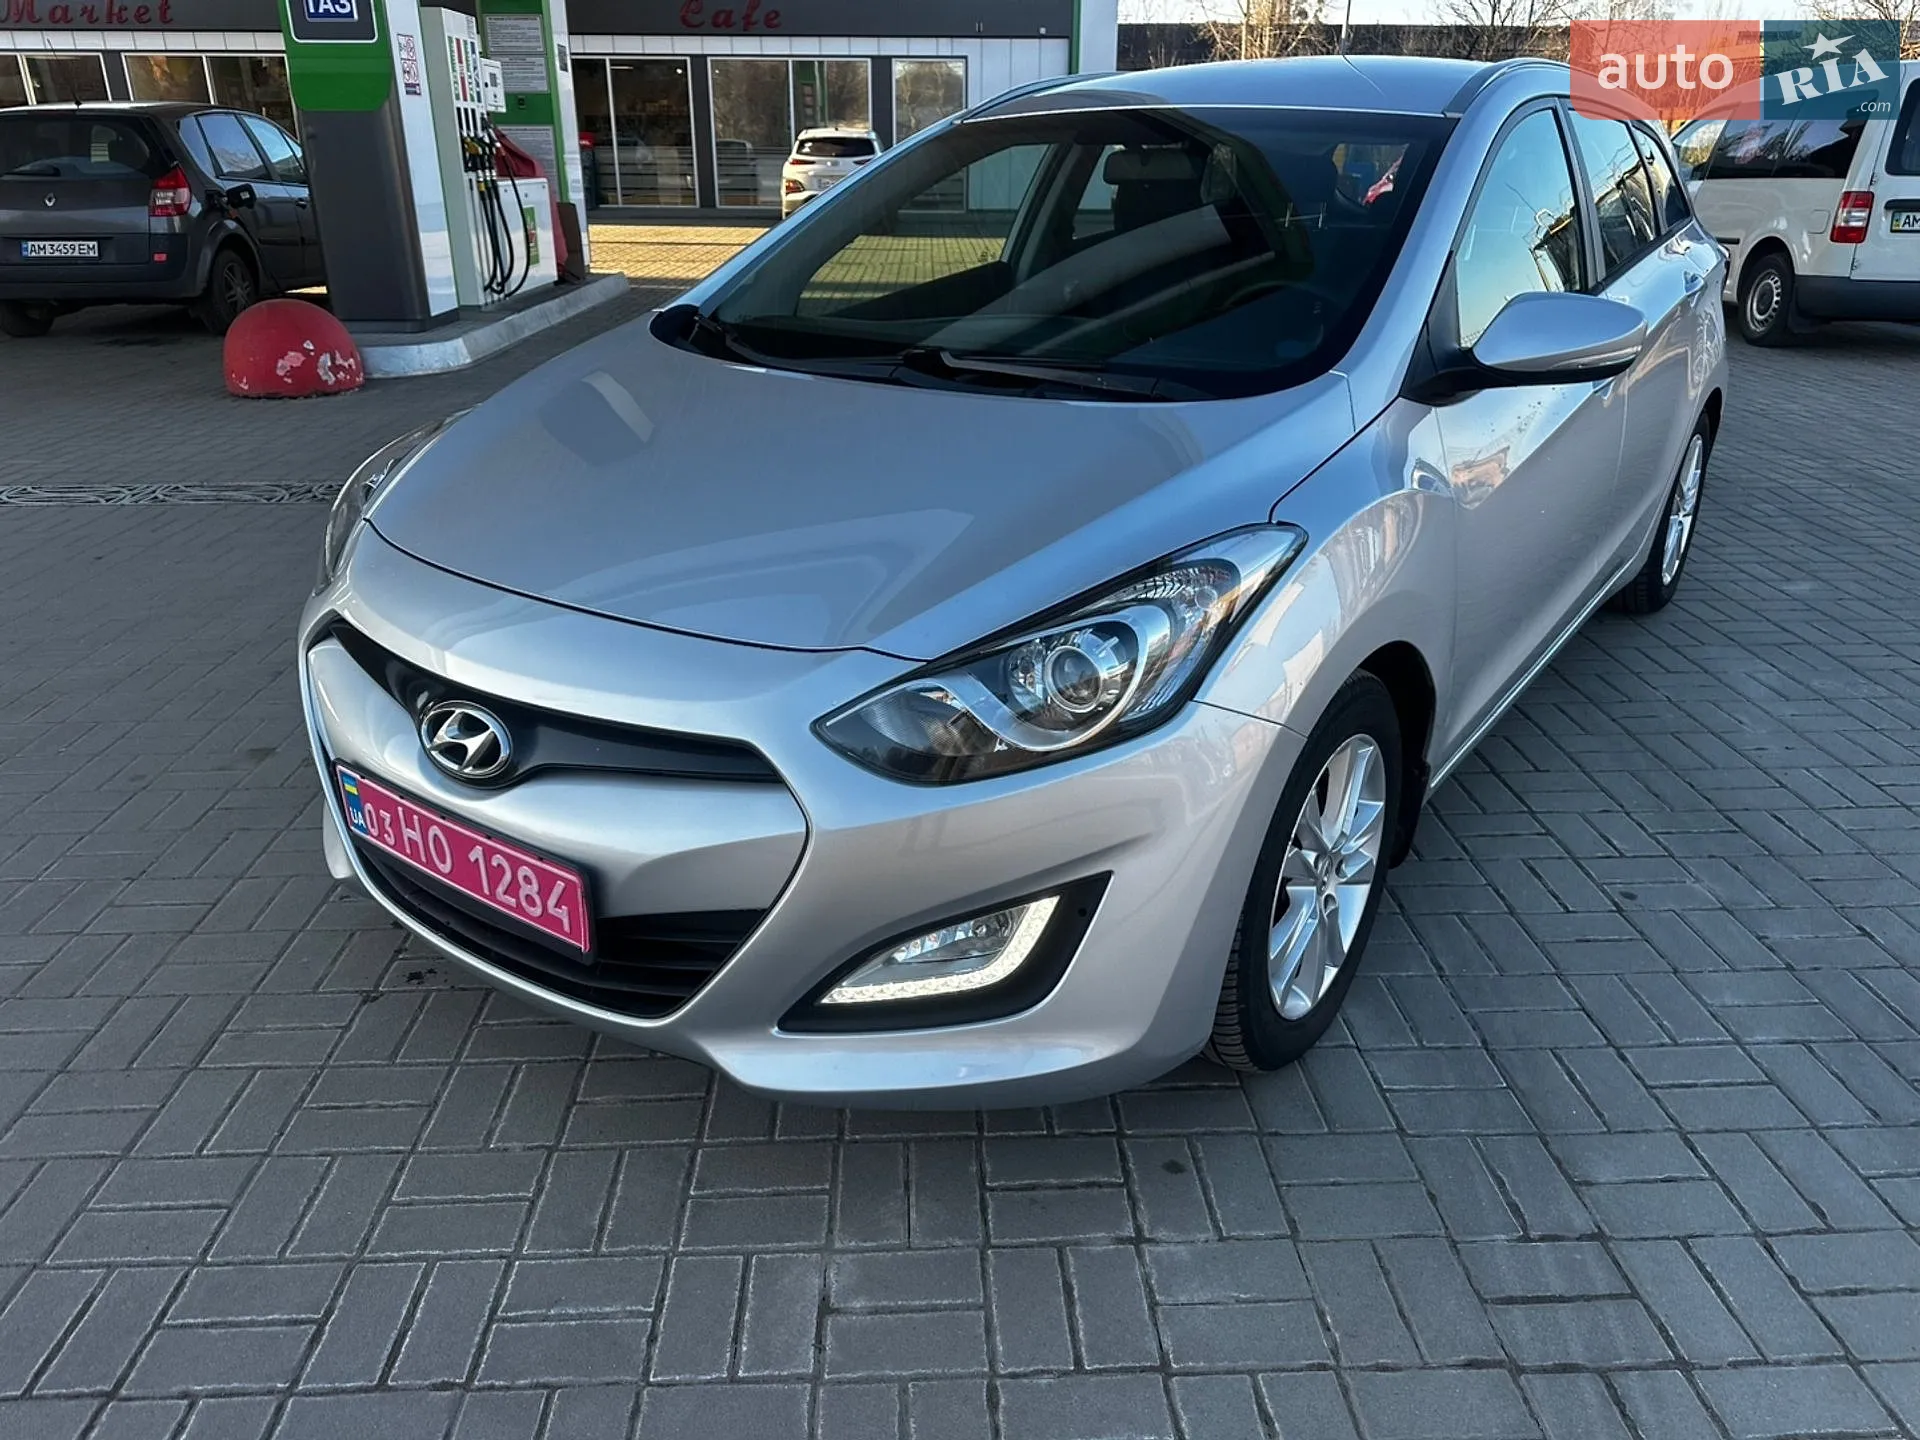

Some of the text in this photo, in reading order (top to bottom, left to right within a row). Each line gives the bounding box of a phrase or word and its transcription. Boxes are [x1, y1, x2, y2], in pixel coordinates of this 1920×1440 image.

[0, 0, 173, 24] Market
[680, 0, 782, 31] Cafe
[29, 243, 96, 255] AM 3459 EM
[349, 806, 367, 829] UA
[364, 803, 572, 934] 03 HO 1284
